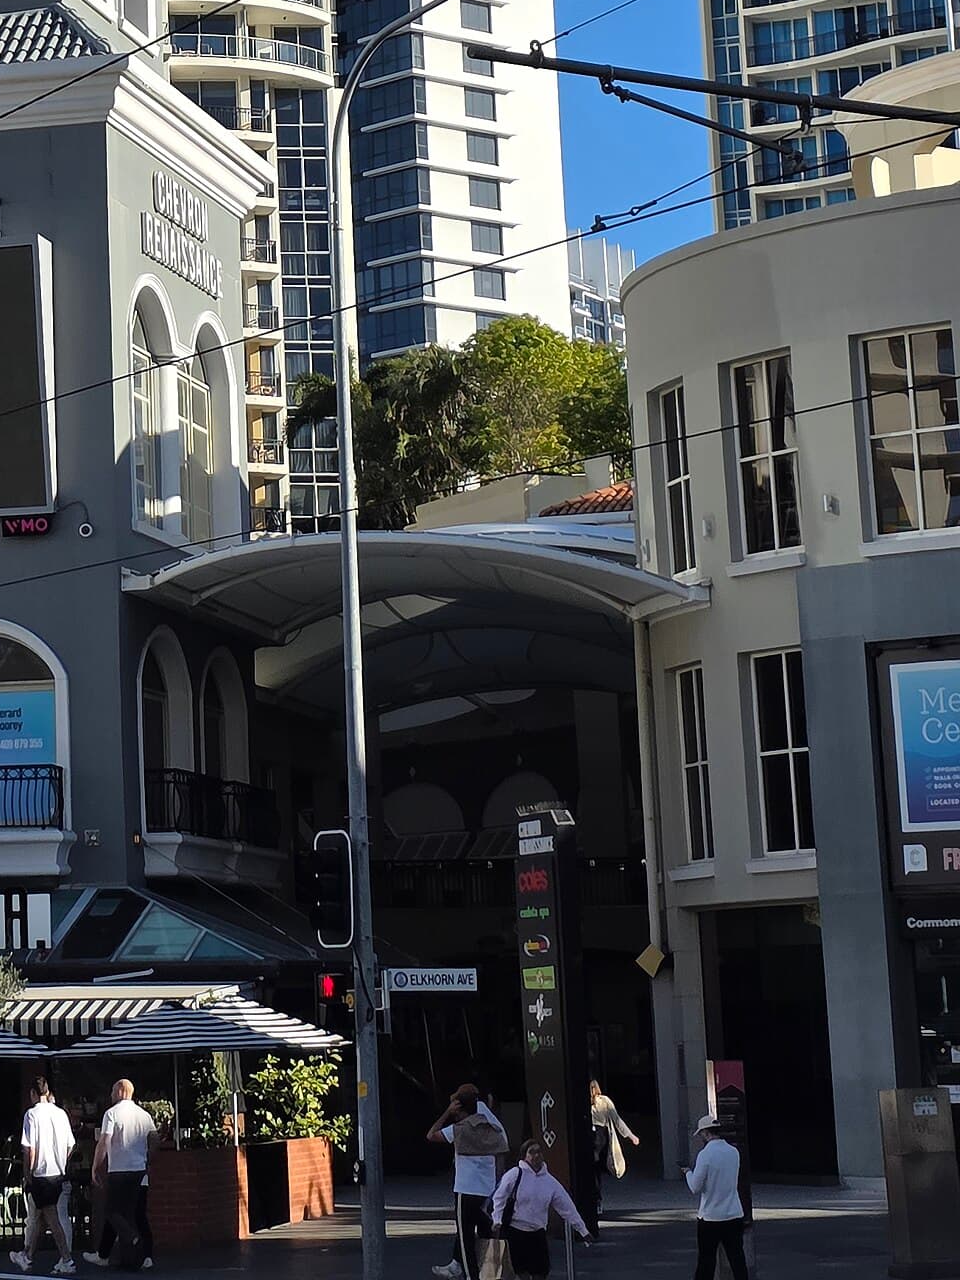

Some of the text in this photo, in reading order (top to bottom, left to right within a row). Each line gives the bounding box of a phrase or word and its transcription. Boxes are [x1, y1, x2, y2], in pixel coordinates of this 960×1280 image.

[152, 170, 209, 243] CHEVRON
[141, 209, 224, 300] RENAISSANCE
[409, 973, 475, 986] ELKHORN AVE
